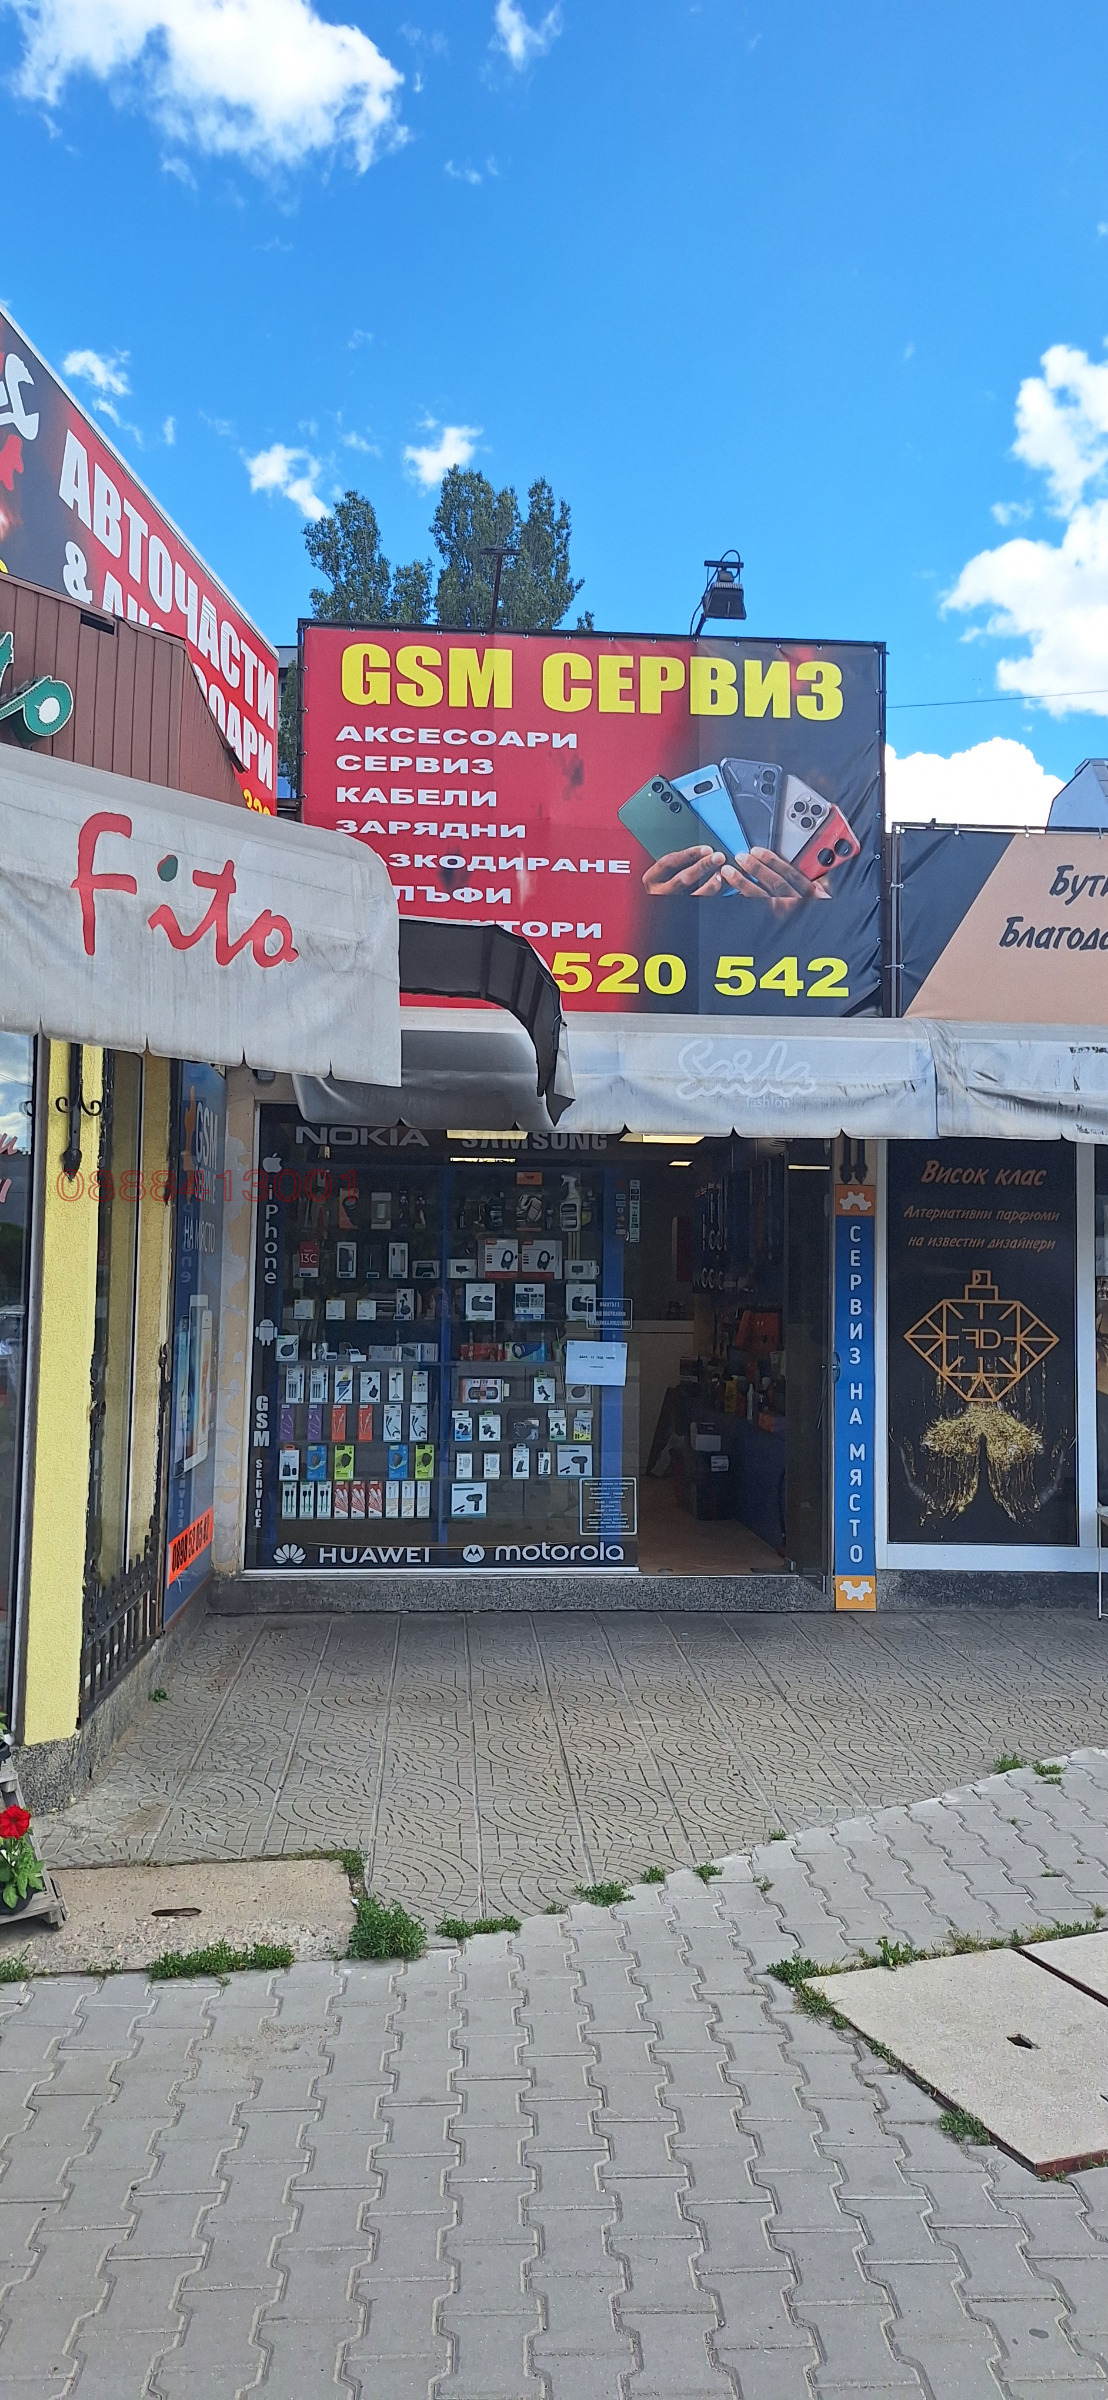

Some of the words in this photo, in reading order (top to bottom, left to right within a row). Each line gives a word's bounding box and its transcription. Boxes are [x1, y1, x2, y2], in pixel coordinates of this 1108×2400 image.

[58, 428, 275, 731] АВТОЧАСТИ
[341, 643, 513, 709] GSM
[542, 652, 844, 721] СЕРВИЗ
[335, 725, 578, 749] АКСЕСОАРИ
[336, 754, 494, 775] СЕРВИЗ
[336, 786, 497, 807] КАБЕЛИ
[336, 819, 526, 840] ЗАРЯДНИ
[376, 853, 631, 873] ЗКОДИРАНЕ
[392, 885, 512, 904] ЛЪФИ
[551, 952, 687, 995] 520
[714, 956, 849, 998] 542
[196, 1101, 218, 1171] GSM
[295, 1126, 430, 1147] NOKIA
[920, 1159, 989, 1185] Висок
[994, 1168, 1047, 1187] клас
[903, 1204, 993, 1222] Алтернативни
[996, 1210, 1060, 1224] парфюми
[264, 1184, 278, 1284] iPhone
[908, 1235, 923, 1247] на
[927, 1236, 985, 1248] известни
[987, 1236, 1056, 1253] дизайнери
[849, 1225, 863, 1365] СЕРВИЗ
[849, 1382, 863, 1425] НА
[253, 1395, 269, 1447] GSM
[255, 1459, 263, 1528] SERVICE
[849, 1443, 865, 1563] МЯСТО
[318, 1546, 430, 1563] HUAWEI
[494, 1542, 624, 1561] motorola
